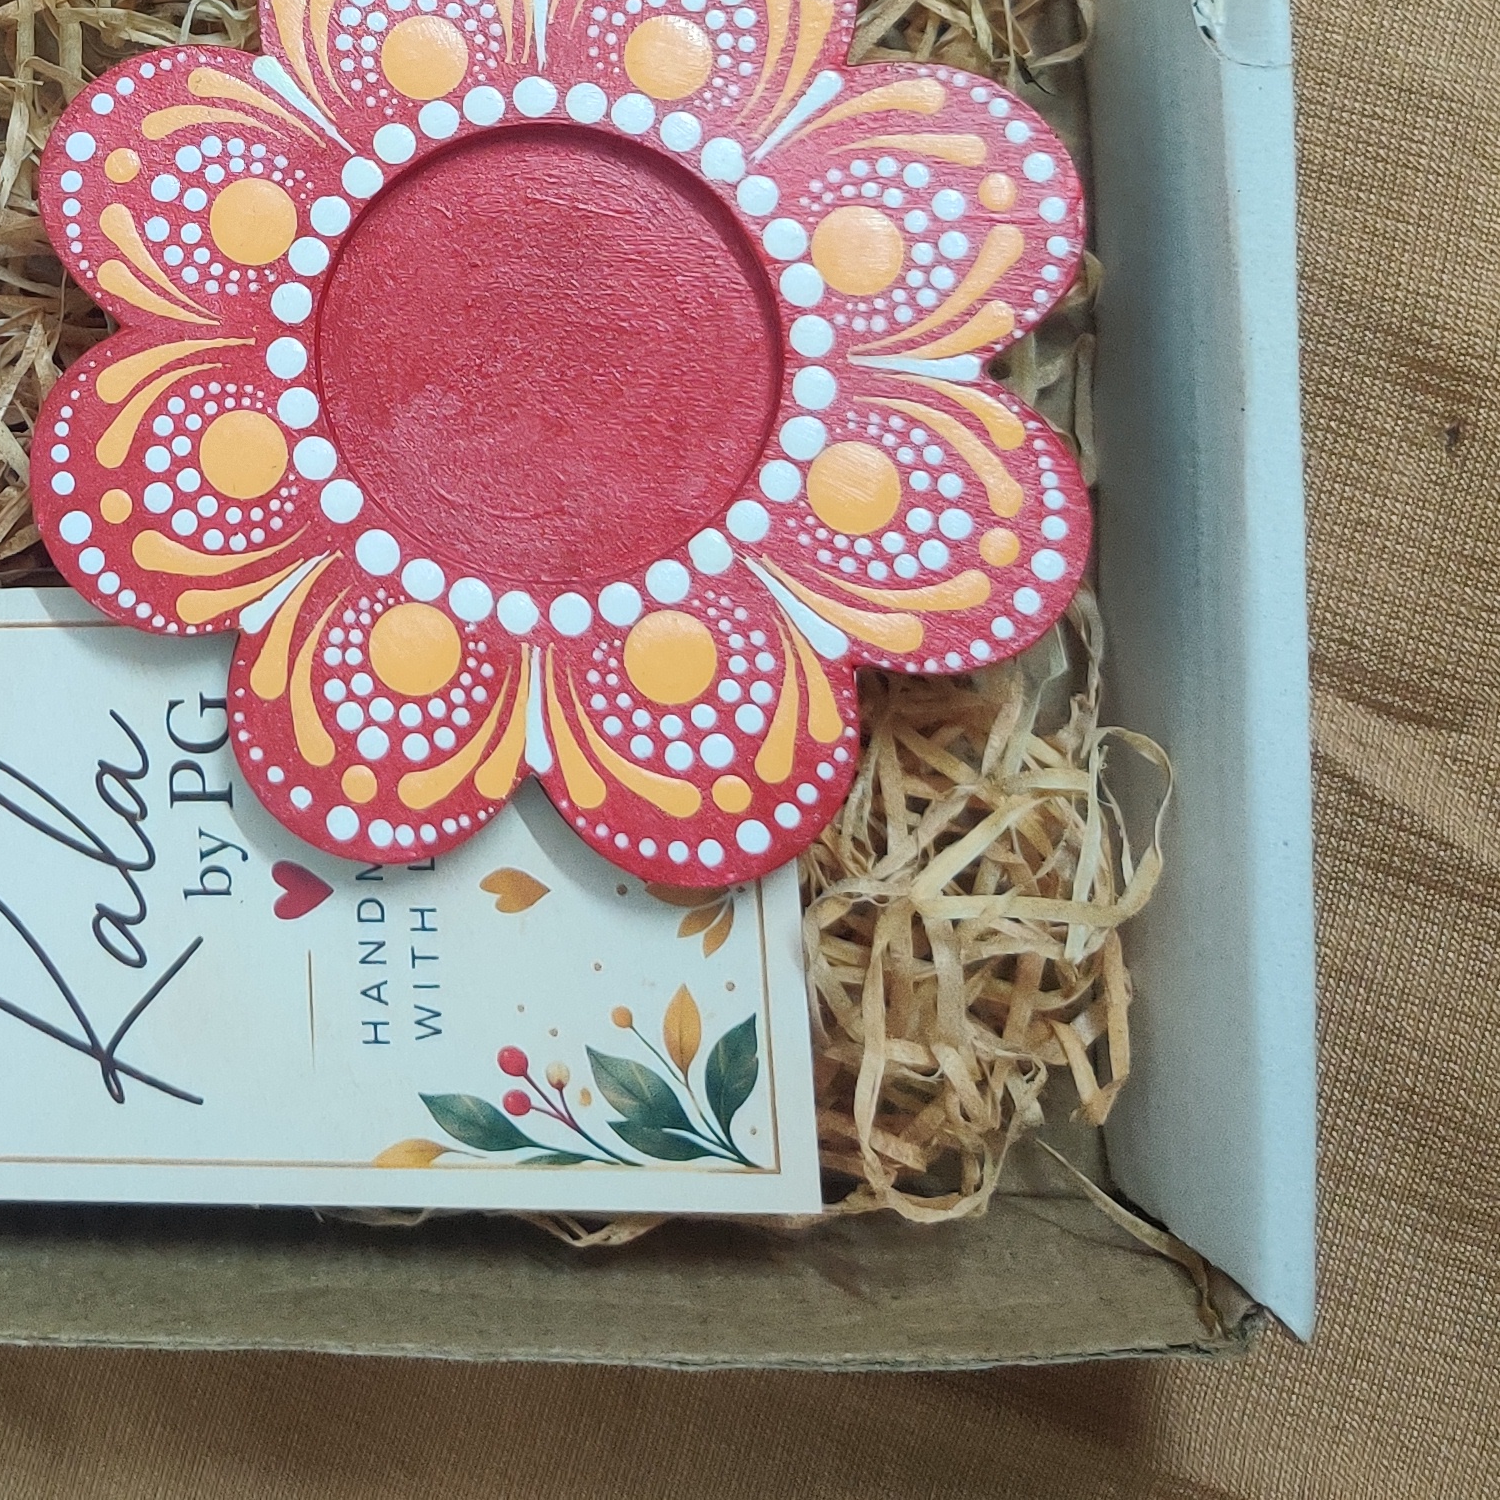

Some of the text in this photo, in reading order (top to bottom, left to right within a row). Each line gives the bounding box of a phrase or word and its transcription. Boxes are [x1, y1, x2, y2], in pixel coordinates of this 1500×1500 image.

[165, 691, 248, 900] by PG
[355, 862, 390, 1045] HANDM
[408, 905, 442, 1041] WITH
